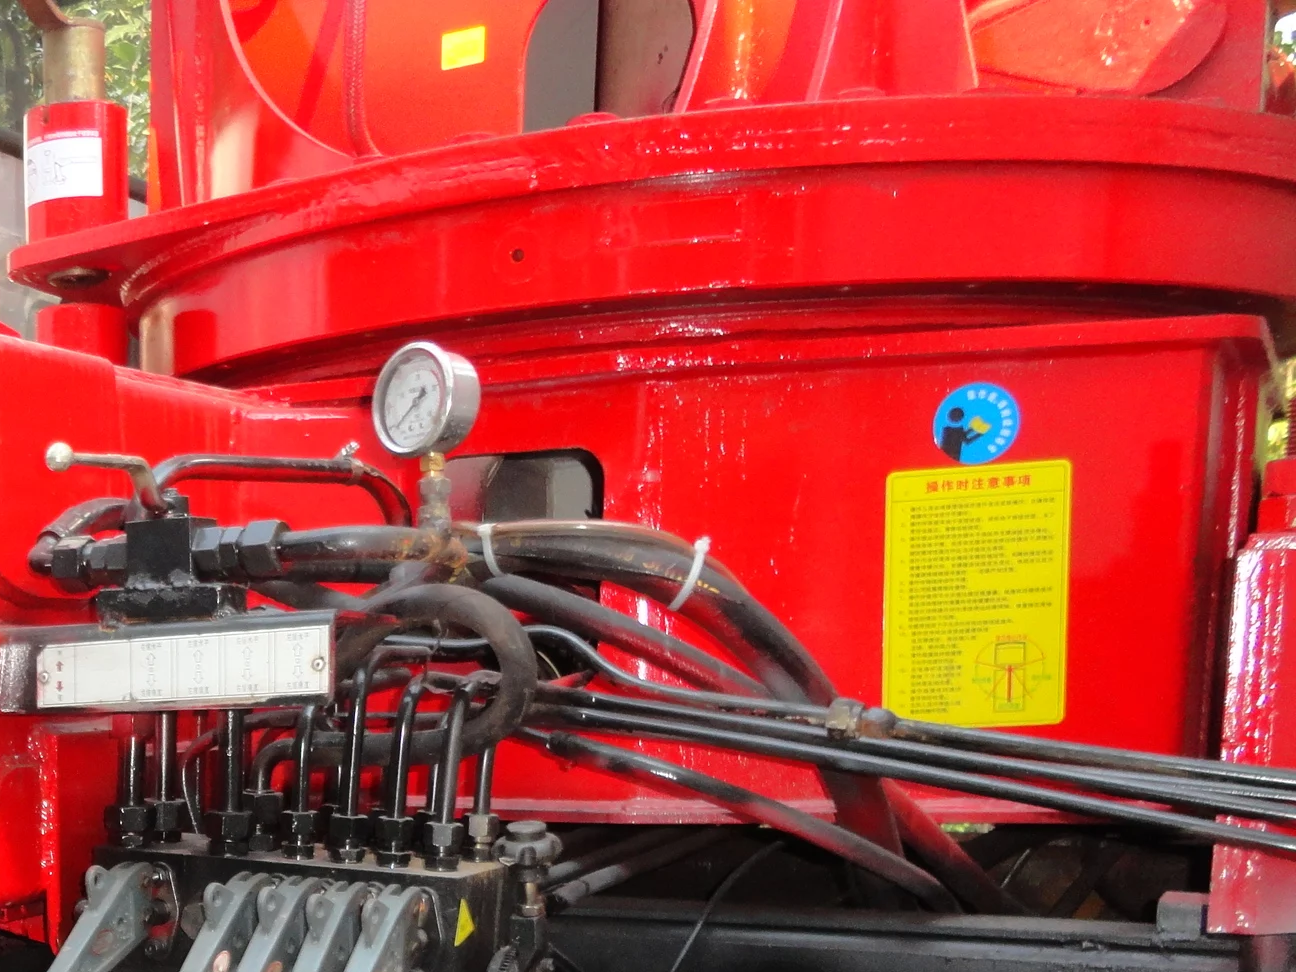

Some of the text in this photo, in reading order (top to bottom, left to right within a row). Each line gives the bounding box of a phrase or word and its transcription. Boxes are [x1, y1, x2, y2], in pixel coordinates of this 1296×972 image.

[925, 475, 1031, 493] 操作时注意事项
